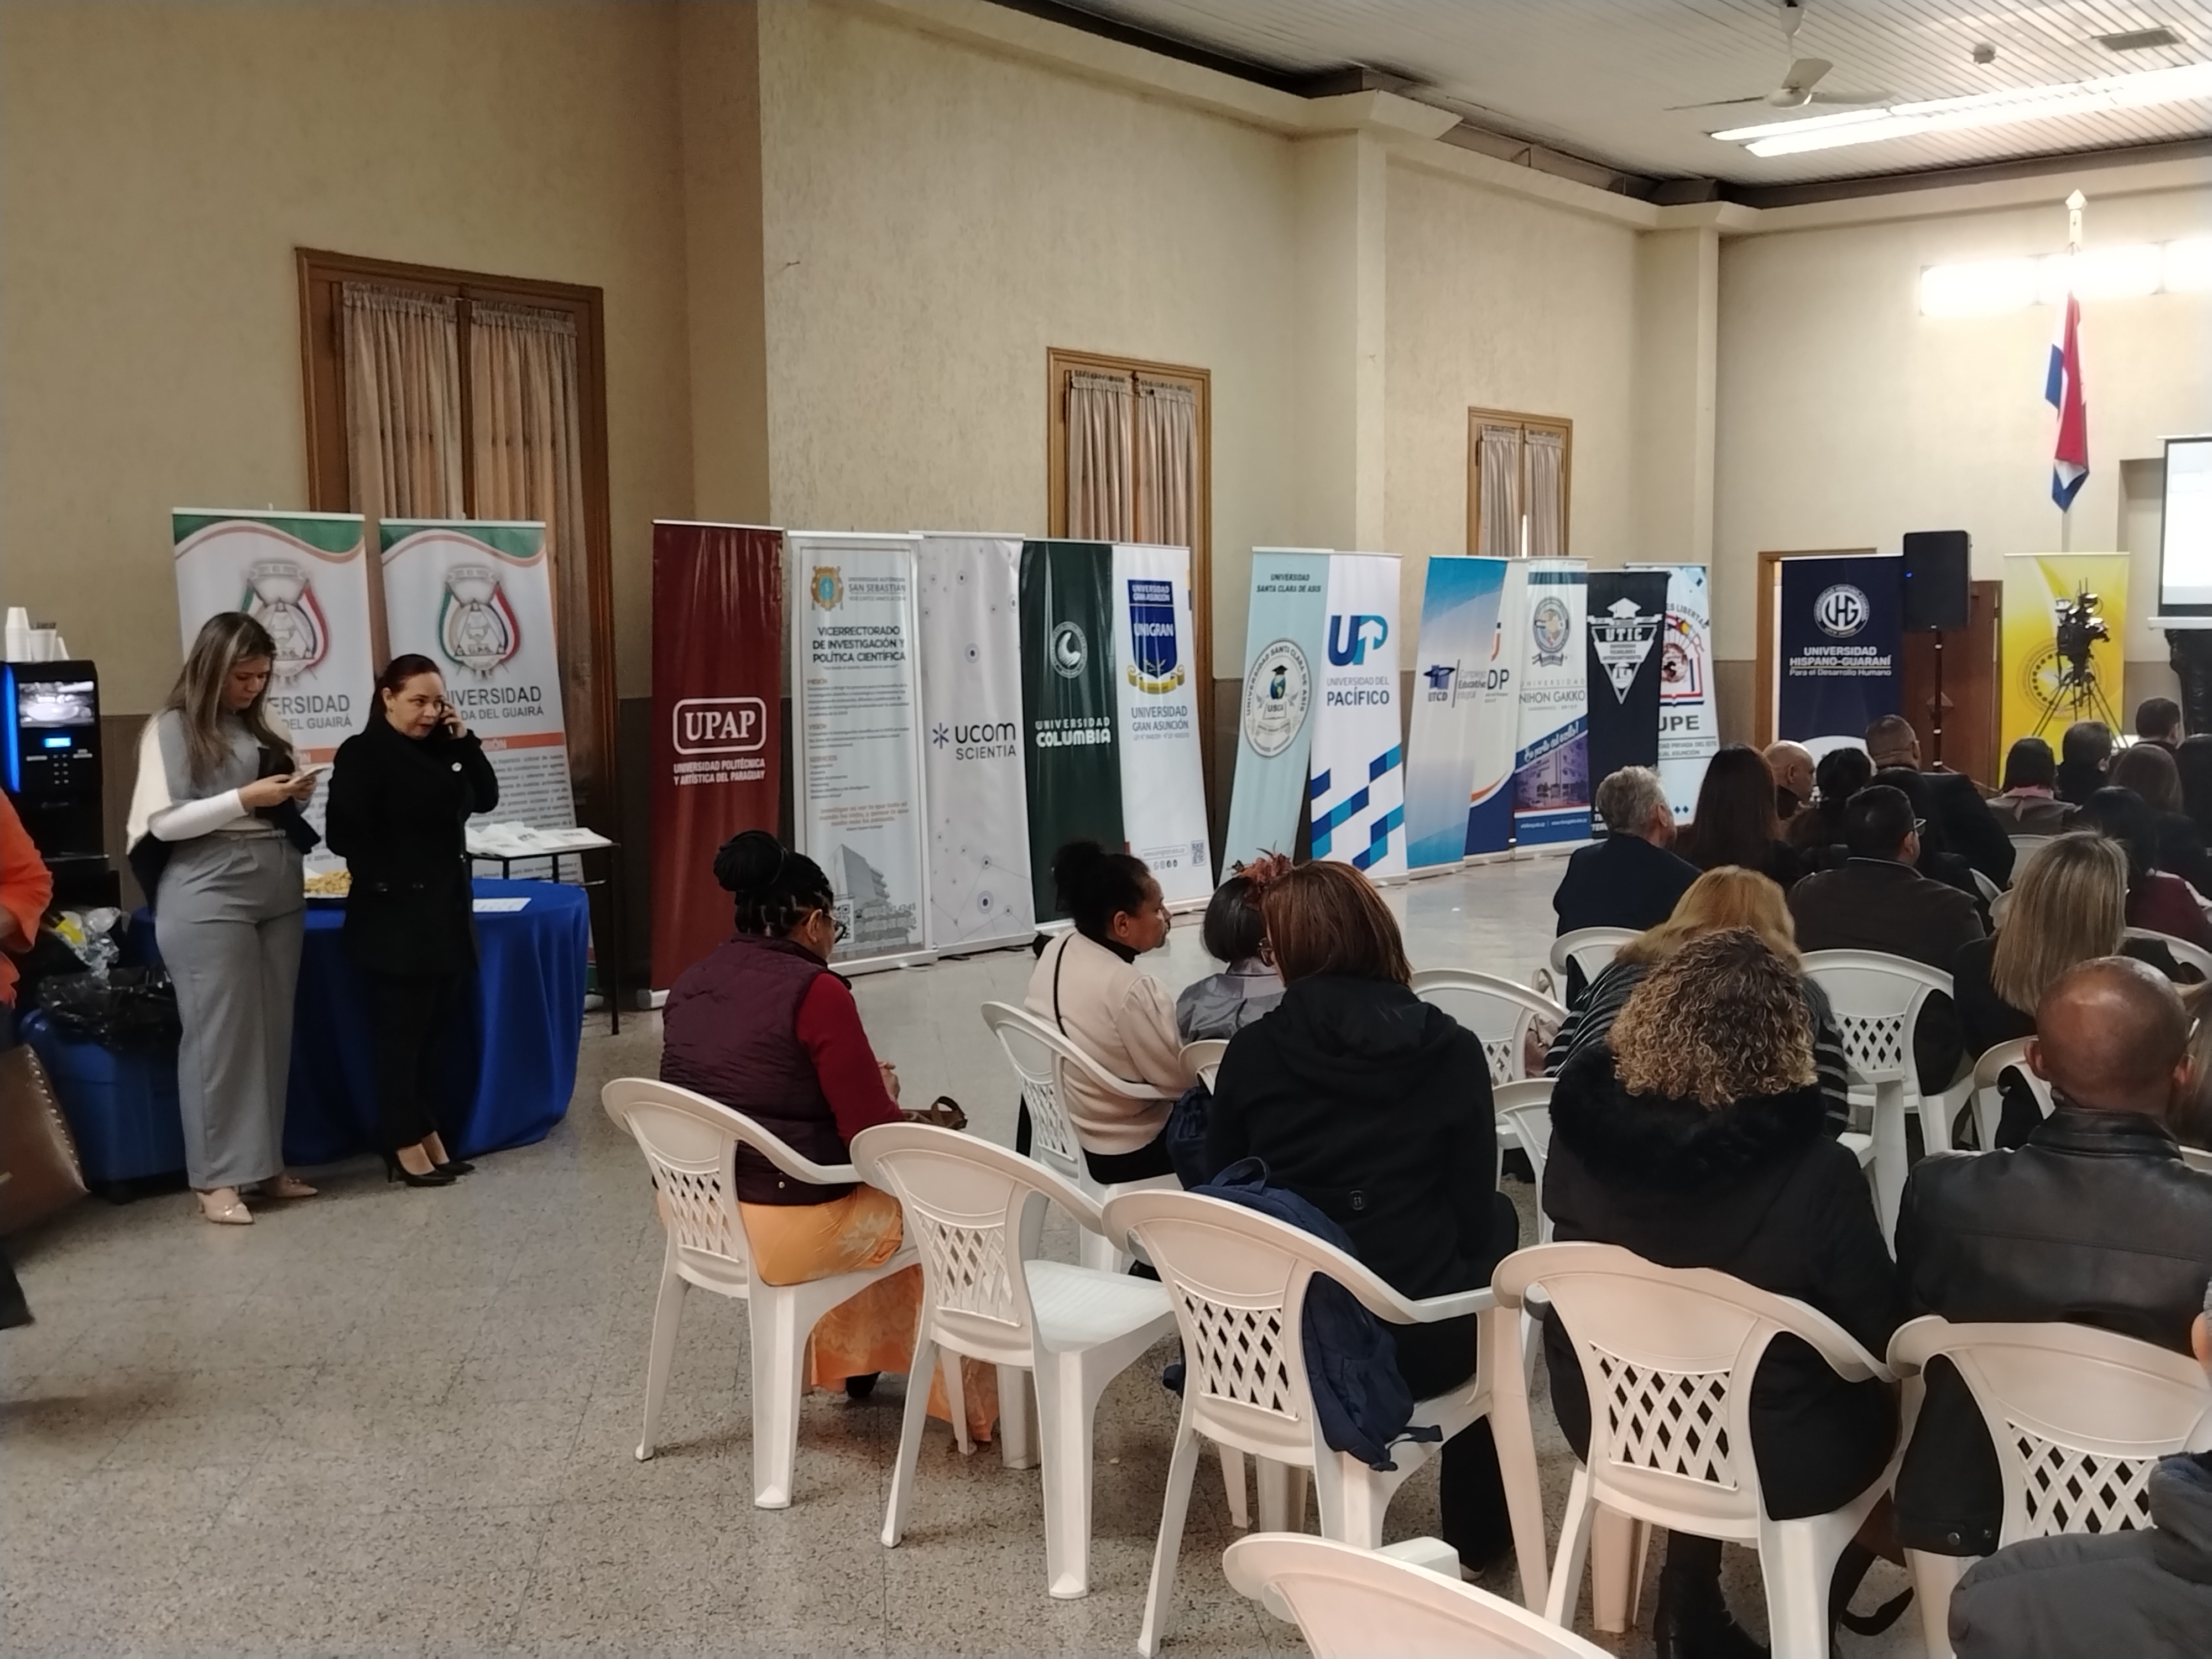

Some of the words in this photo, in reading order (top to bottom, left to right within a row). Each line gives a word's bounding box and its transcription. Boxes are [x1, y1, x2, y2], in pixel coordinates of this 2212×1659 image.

[848, 584, 864, 592] SAN
[1132, 585, 1170, 593] UNIVERSIDAD
[817, 626, 900, 636] VICERRECTORADO
[1134, 623, 1173, 637] UNIGRAN
[1605, 628, 1642, 641] UTIC
[812, 640, 826, 649] DE
[828, 637, 897, 649] INVESTIGACIÓN
[899, 639, 905, 648] Y
[1328, 615, 1389, 666] UP
[813, 651, 854, 663] POLÍTICA
[857, 650, 906, 662] CIENTÍFICA
[1803, 646, 1877, 656] UNIVERSIDAD
[1790, 654, 1892, 666] HISPANO-GUARANÍ
[1246, 653, 1269, 716] UNIVERSIDAD
[1271, 645, 1290, 656] SANTA
[1290, 649, 1305, 672] CLARA
[1302, 673, 1307, 686] DE
[1327, 677, 1374, 686] UNIVERSIDAD
[1375, 676, 1389, 686] DEL
[1487, 669, 1510, 690] DP
[1520, 678, 1584, 687] UNIVERSIDAD
[447, 686, 541, 706] IVERSIDAD
[1327, 686, 1390, 706] PACÍFICO
[1519, 691, 1551, 705] NIHON
[1553, 690, 1585, 702] GAKKO
[268, 695, 350, 715] ERSIDAD
[461, 709, 476, 721] DA
[479, 708, 500, 719] DEL
[502, 703, 544, 718] GUAIRÁ
[1131, 705, 1188, 718] UNIVERSIDAD
[307, 713, 352, 729] GUAIRÁ
[685, 710, 756, 741] UPAP
[1035, 717, 1110, 730] UNIVERSIDAD
[1132, 721, 1151, 732] GRAN
[1153, 718, 1189, 731] ASUNCIÓN
[1036, 728, 1111, 747] COLUMBIA
[956, 745, 1016, 760] SCIENTIA
[674, 760, 720, 774] UNIVERSIDAD
[721, 757, 765, 770] POLITÉCNICA
[674, 775, 679, 786] Y
[680, 773, 715, 786] ARTÍSTICA
[716, 772, 729, 783] DEL
[730, 770, 766, 781] PARAGUAY
